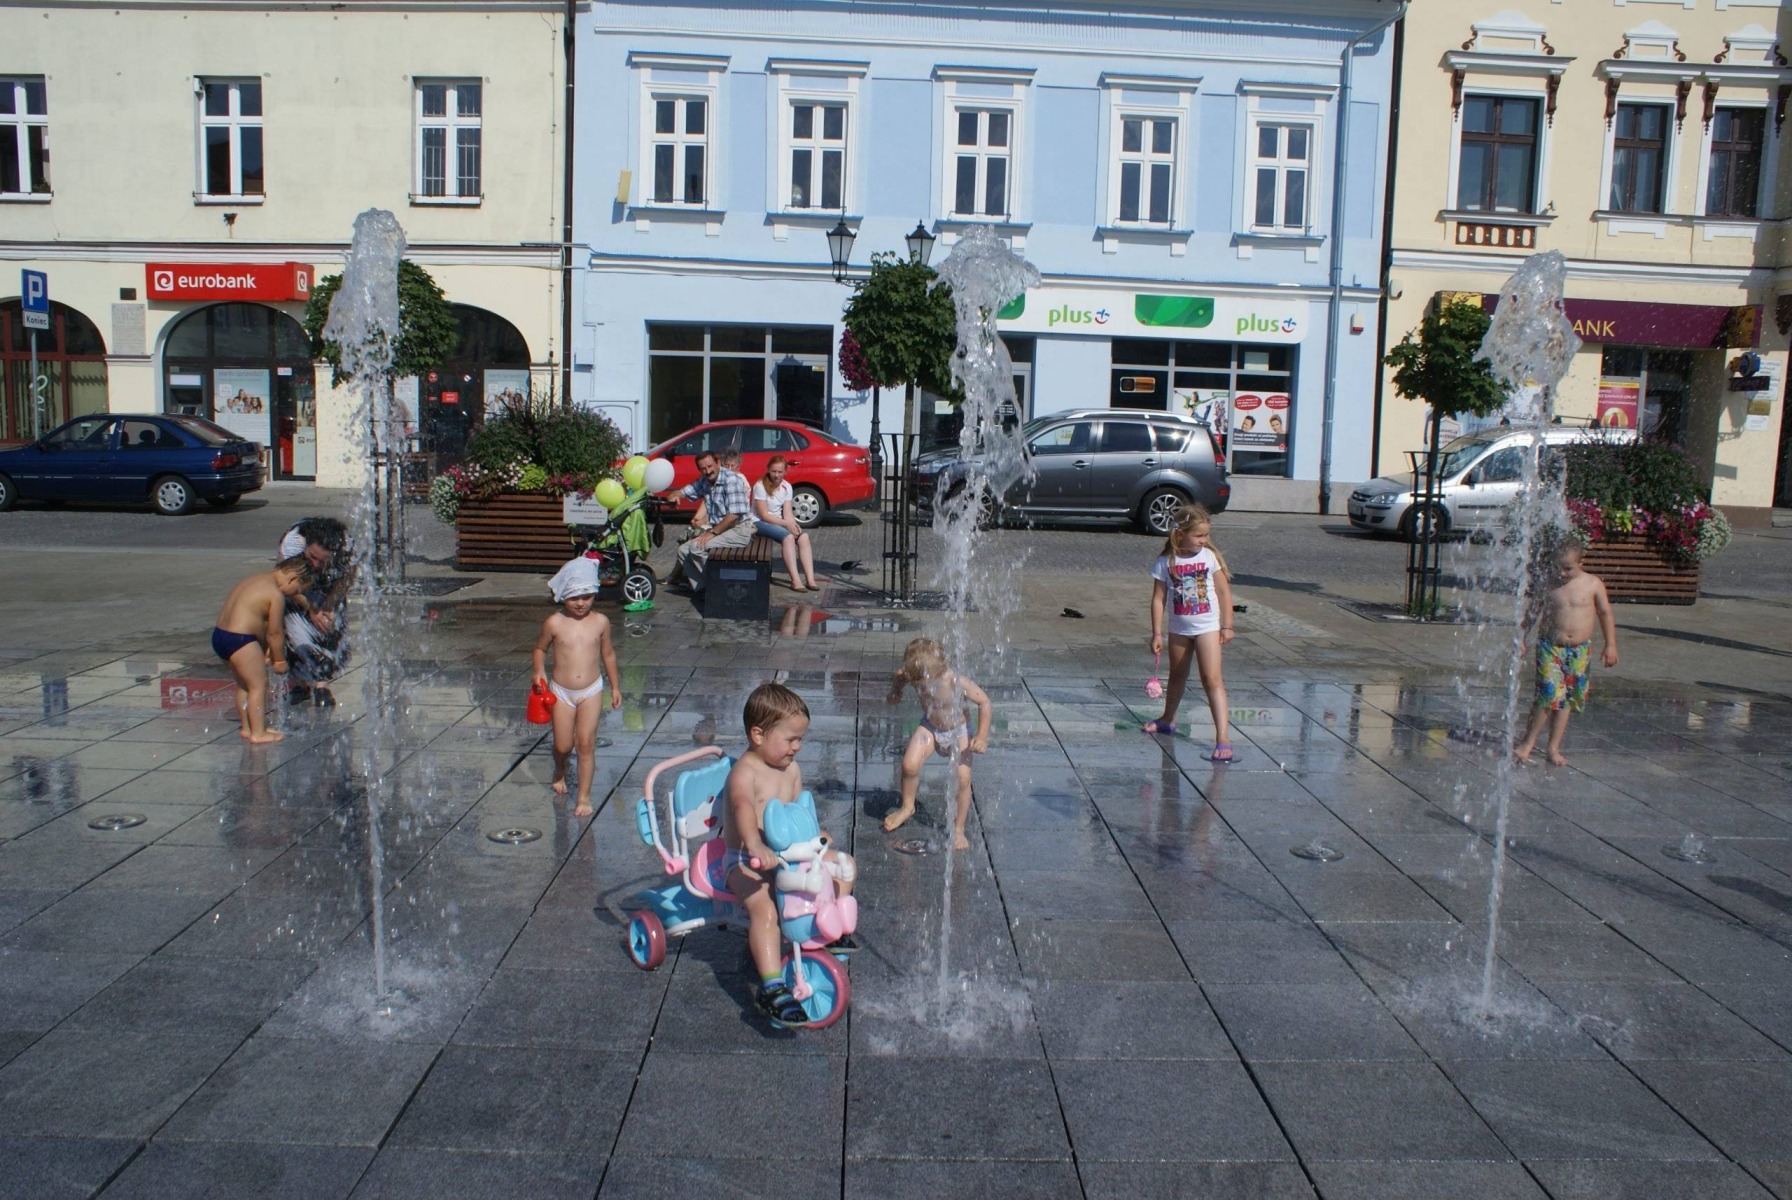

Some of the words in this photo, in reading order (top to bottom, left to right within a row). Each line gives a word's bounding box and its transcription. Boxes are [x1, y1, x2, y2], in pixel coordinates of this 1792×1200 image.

[28, 274, 43, 306] P
[178, 273, 257, 288] eurobank
[26, 314, 47, 325] Koniec
[1048, 304, 1092, 327] plus
[1236, 313, 1280, 335] plus
[1572, 319, 1616, 337] ANK
